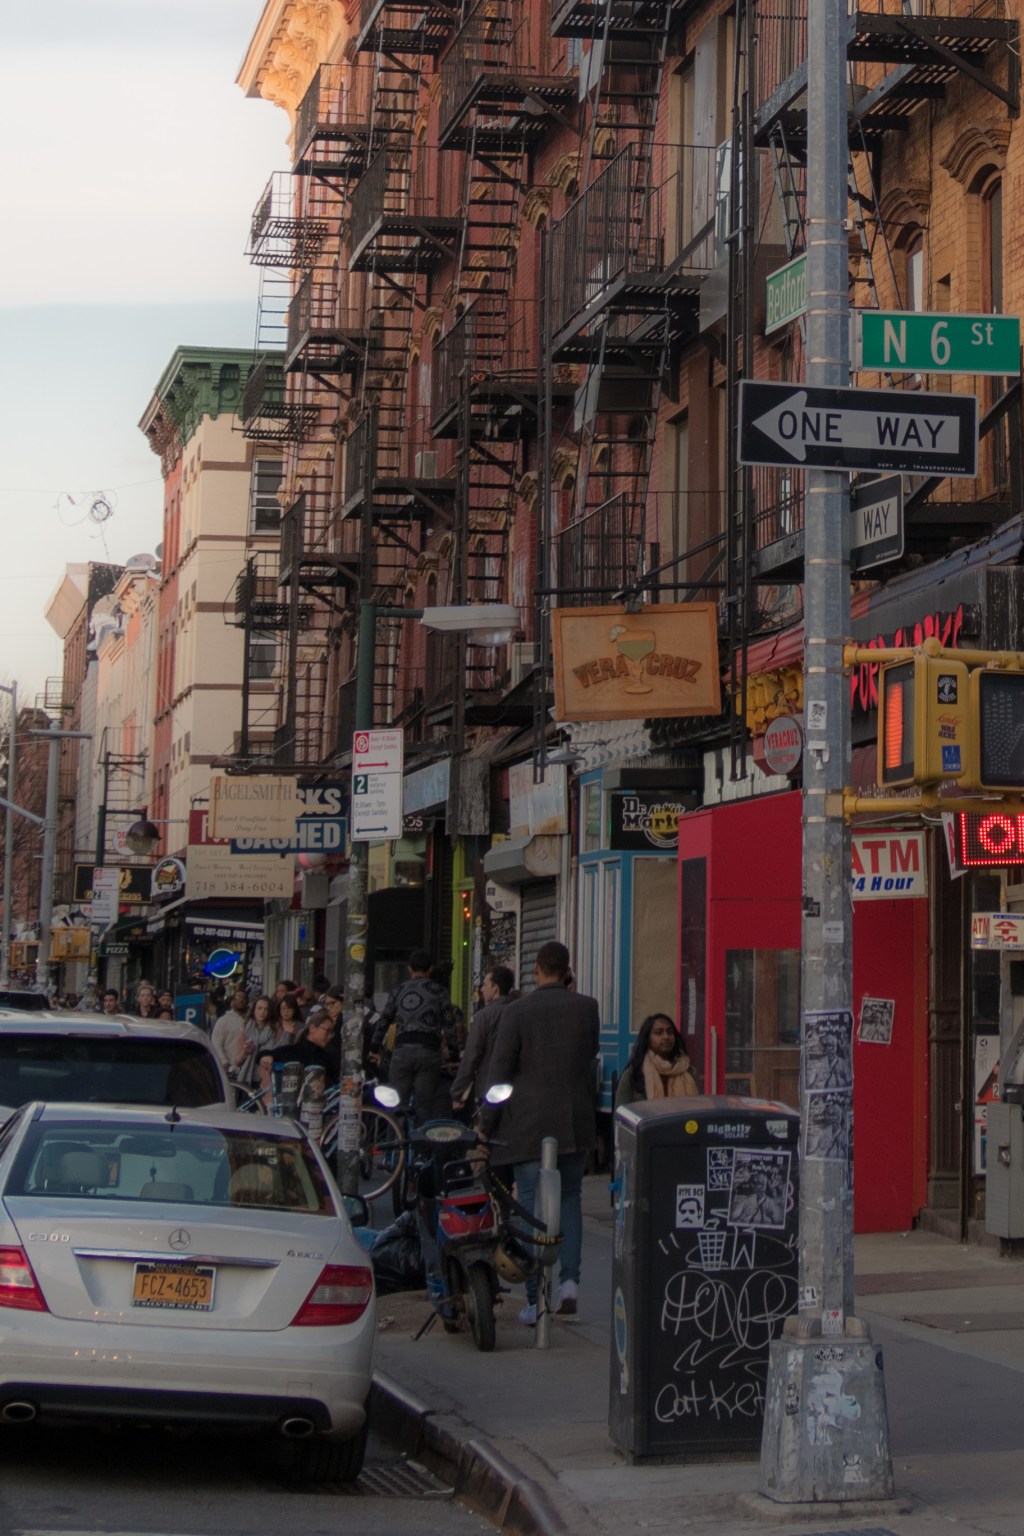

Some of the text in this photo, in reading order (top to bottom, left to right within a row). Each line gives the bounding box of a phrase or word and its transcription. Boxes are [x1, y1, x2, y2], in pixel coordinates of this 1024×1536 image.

[768, 260, 807, 325] Bedford
[883, 319, 994, 366] N 6 St
[778, 410, 945, 449] ONE WAY
[863, 503, 891, 540] WAY
[572, 652, 702, 689] VERA CRUZ
[766, 728, 799, 751] VERACRUZ
[213, 784, 292, 801] BAGELSMITH
[356, 776, 365, 794] 2
[851, 839, 920, 874] ATM
[195, 881, 284, 892] 718 384-6004
[870, 876, 914, 892] Hour
[232, 929, 247, 939] FREE
[973, 918, 990, 935] ATM
[707, 1124, 752, 1135] BigBelly
[724, 1132, 746, 1140] SOLAR
[141, 1275, 208, 1298] FCZ 4653
